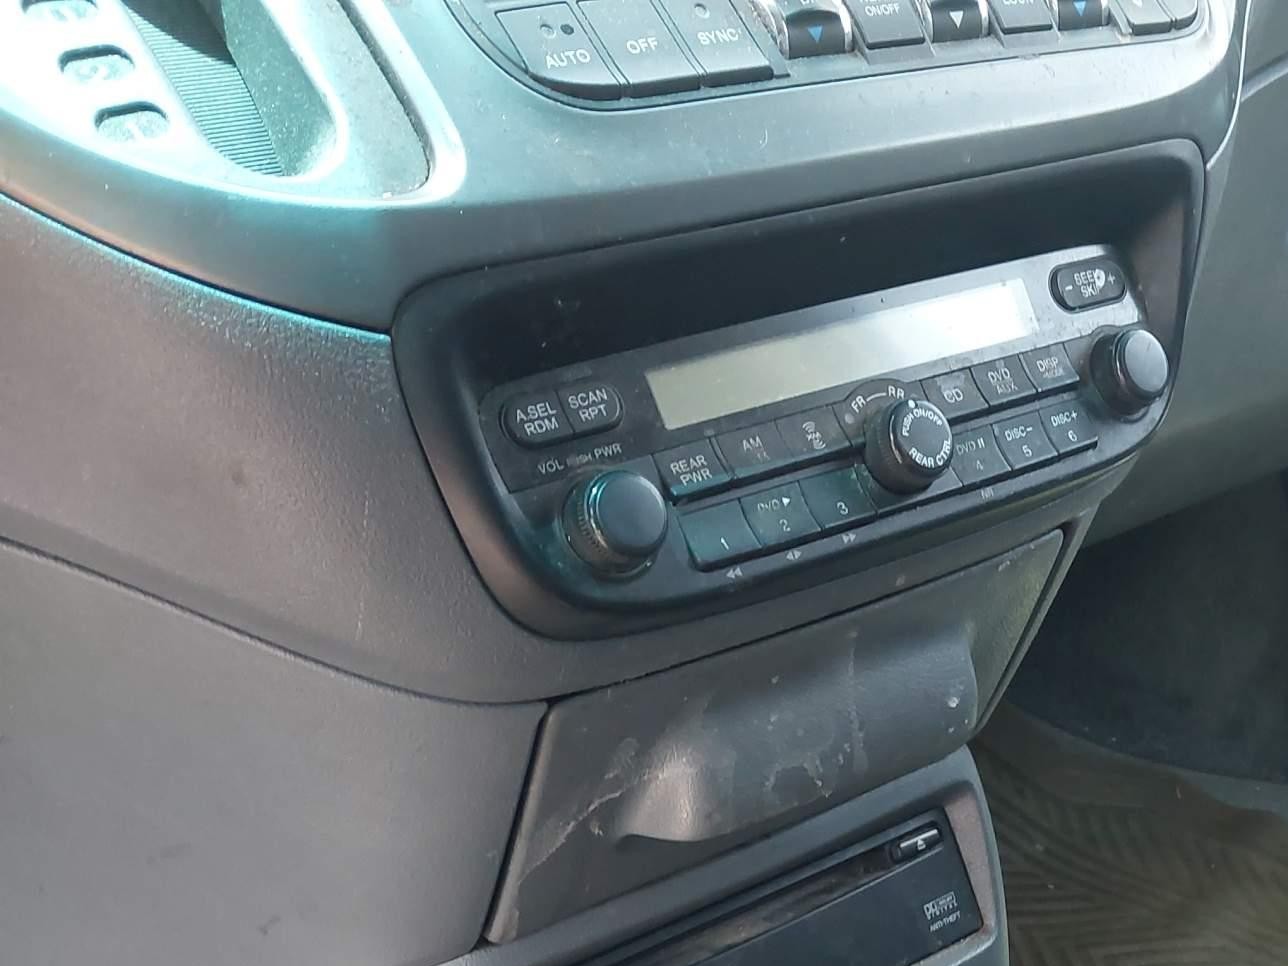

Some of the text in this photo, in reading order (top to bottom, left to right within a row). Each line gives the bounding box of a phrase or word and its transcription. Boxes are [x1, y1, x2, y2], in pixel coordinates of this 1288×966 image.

[864, 3, 900, 17] ON/OFF
[696, 27, 738, 45] SYNC
[626, 37, 659, 55] OFF
[545, 49, 591, 69] AUTO
[987, 366, 1011, 385] DVD
[568, 387, 608, 410] SCAN
[888, 385, 905, 400] RR
[943, 388, 964, 404] CD
[578, 403, 608, 423] RPT
[523, 416, 560, 437] RDM
[742, 434, 764, 451] AM
[1067, 430, 1079, 443] 6
[537, 458, 565, 475] VOL
[593, 442, 623, 460] PWR
[908, 439, 952, 469] REAR CTRL
[1022, 444, 1033, 458] 5
[669, 454, 708, 475] REAR
[679, 467, 713, 487] PWR
[836, 501, 849, 515] 3
[779, 518, 792, 532] 2
[719, 536, 730, 550] 1
